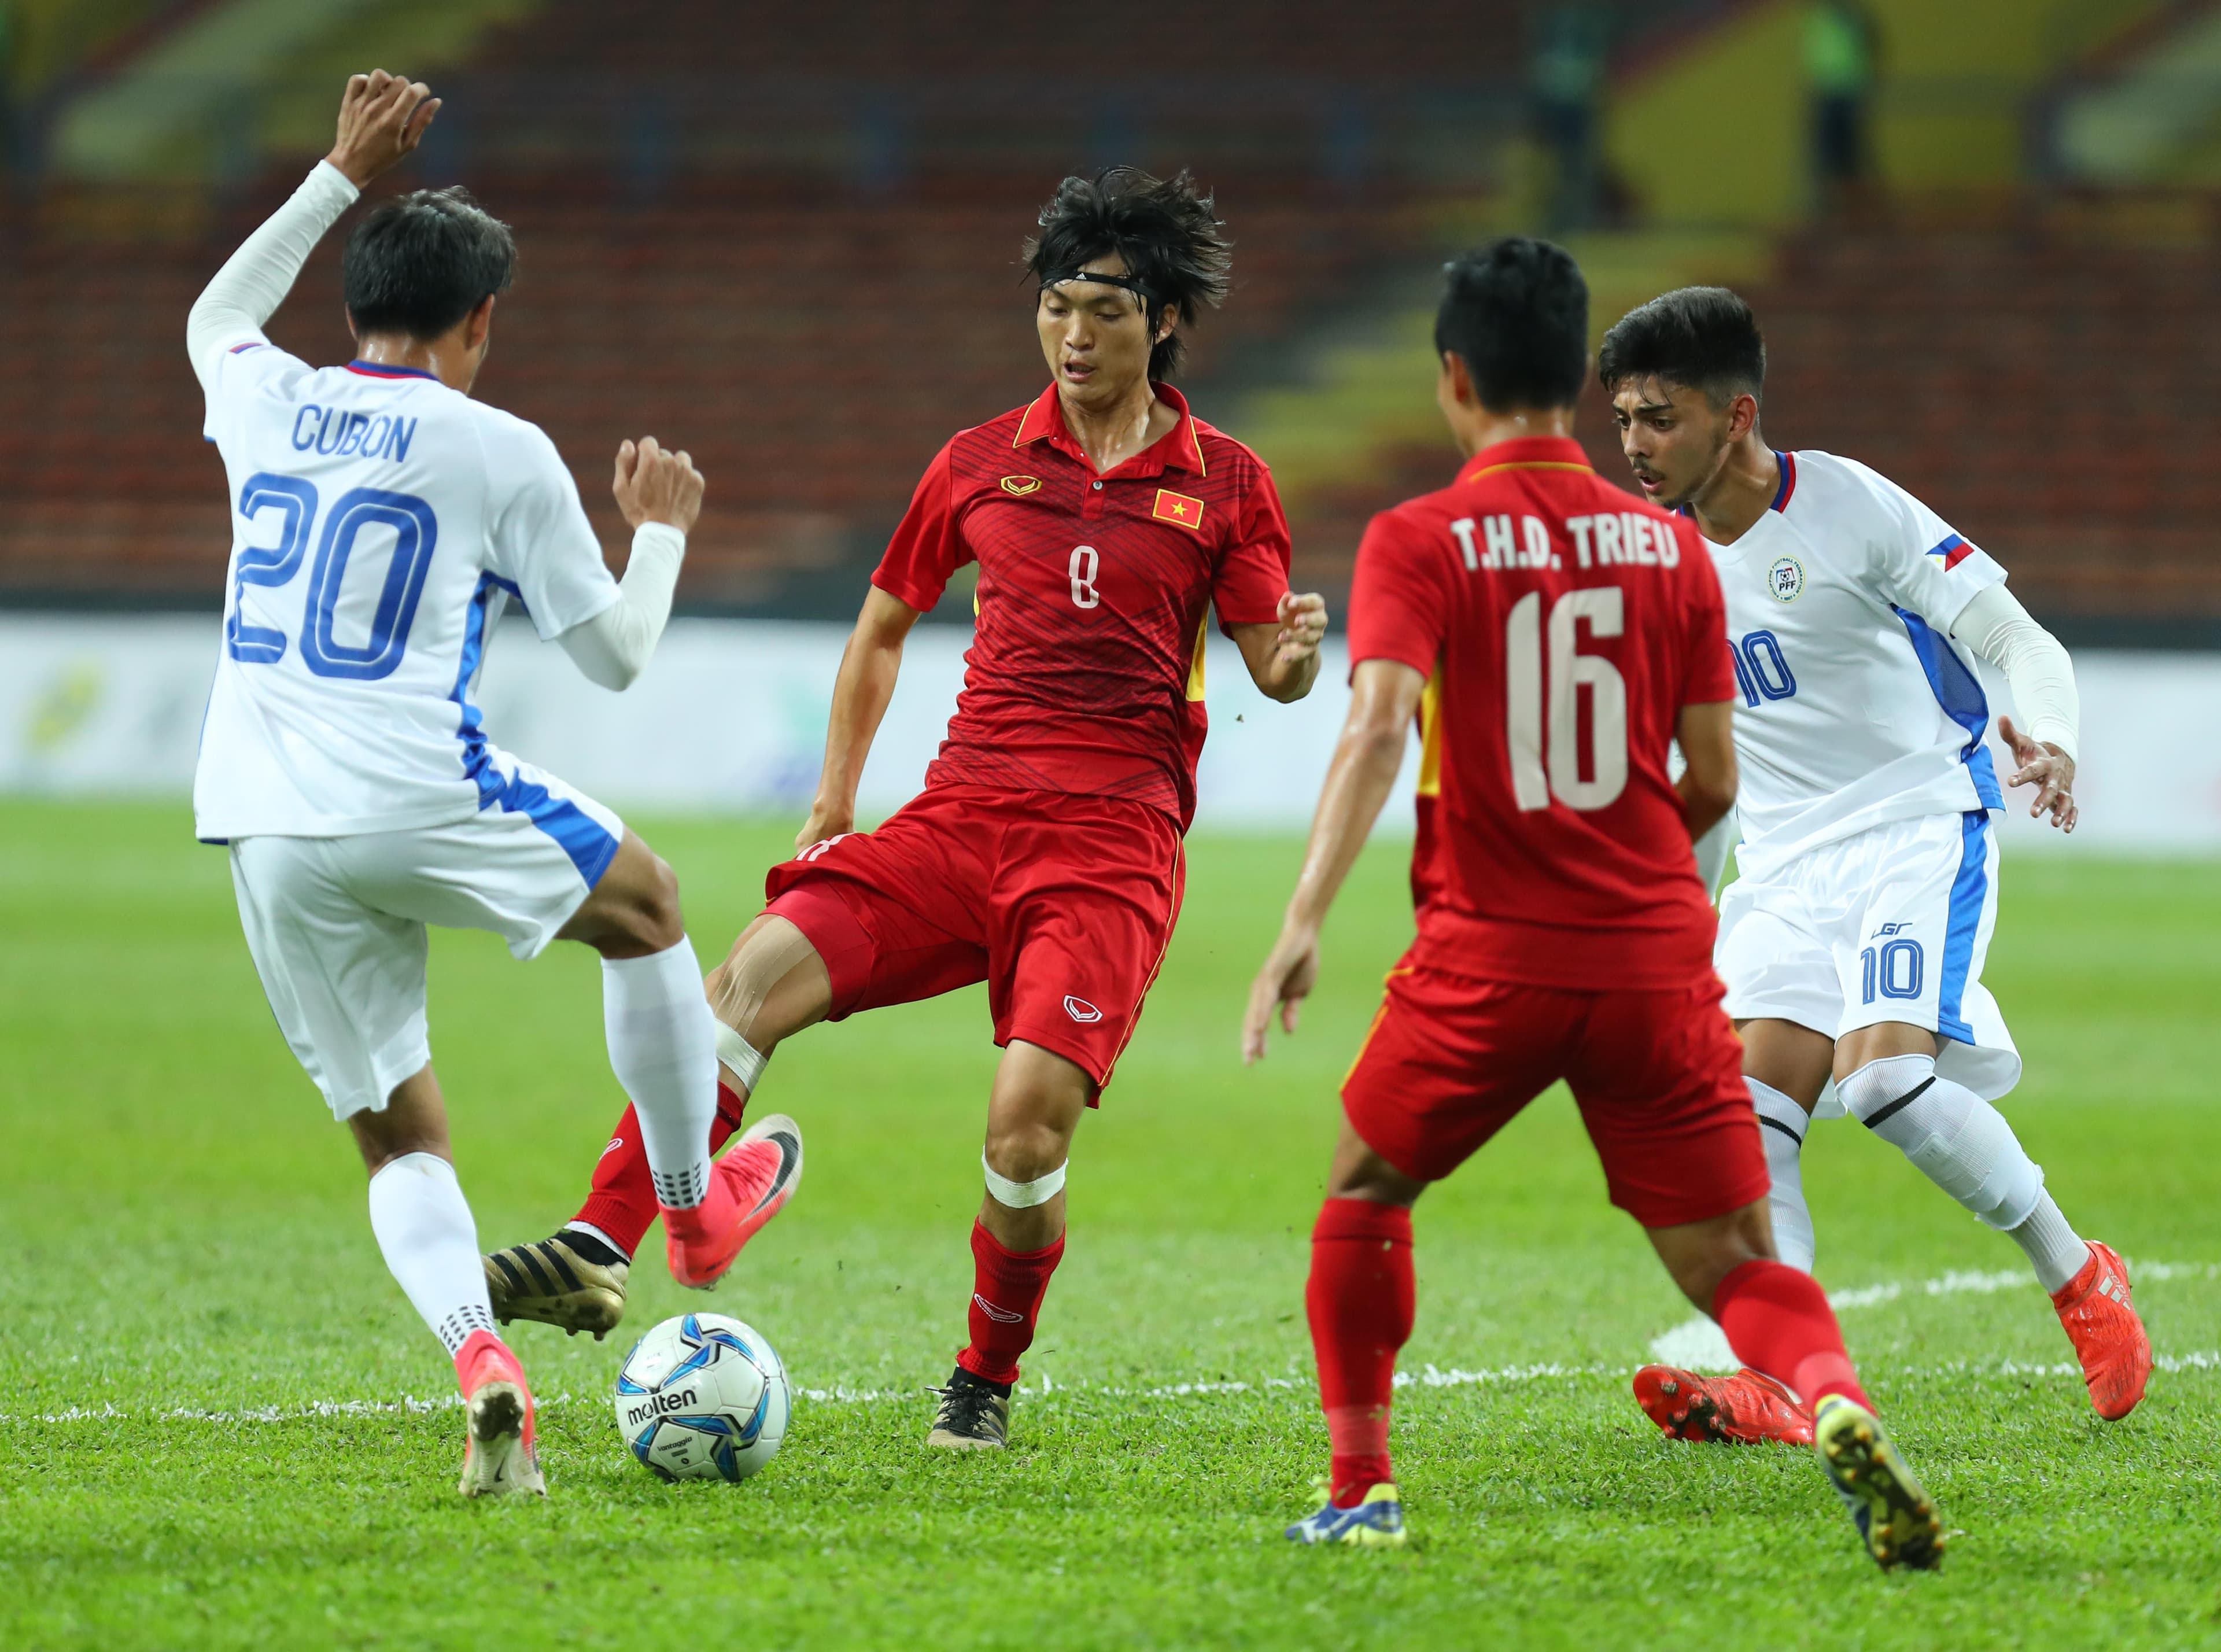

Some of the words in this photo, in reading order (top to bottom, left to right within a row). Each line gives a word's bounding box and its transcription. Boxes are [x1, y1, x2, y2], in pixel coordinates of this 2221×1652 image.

[292, 403, 418, 463] CUBON
[1450, 514, 1562, 571] T.H.D.
[1566, 512, 1679, 569] TRIEU
[1772, 557, 1794, 569] FOOTBALL
[227, 471, 438, 680] 20
[1068, 545, 1100, 609] 8
[1779, 580, 1796, 591] PFF
[1507, 585, 1628, 813] 16
[1726, 629, 1797, 709] 10
[1860, 939, 1924, 1005] 10
[628, 1389, 698, 1426] molten
